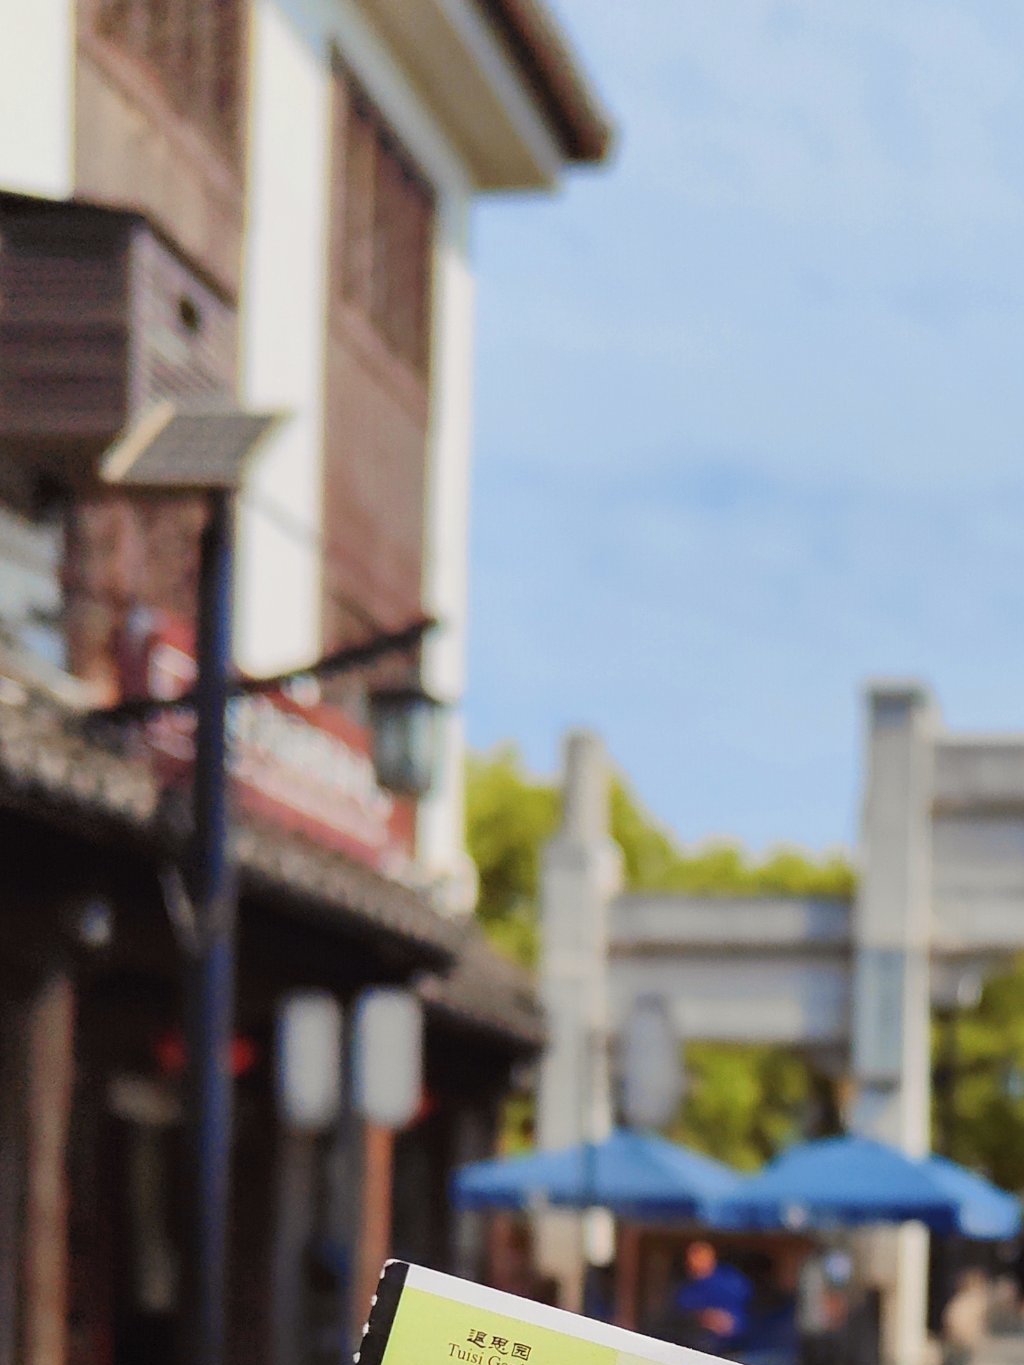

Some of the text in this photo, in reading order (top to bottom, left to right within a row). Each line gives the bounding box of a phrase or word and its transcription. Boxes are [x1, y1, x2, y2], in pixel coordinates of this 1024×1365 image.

[449, 1343, 483, 1365] Tuisi
[467, 1329, 532, 1361] 退思园
